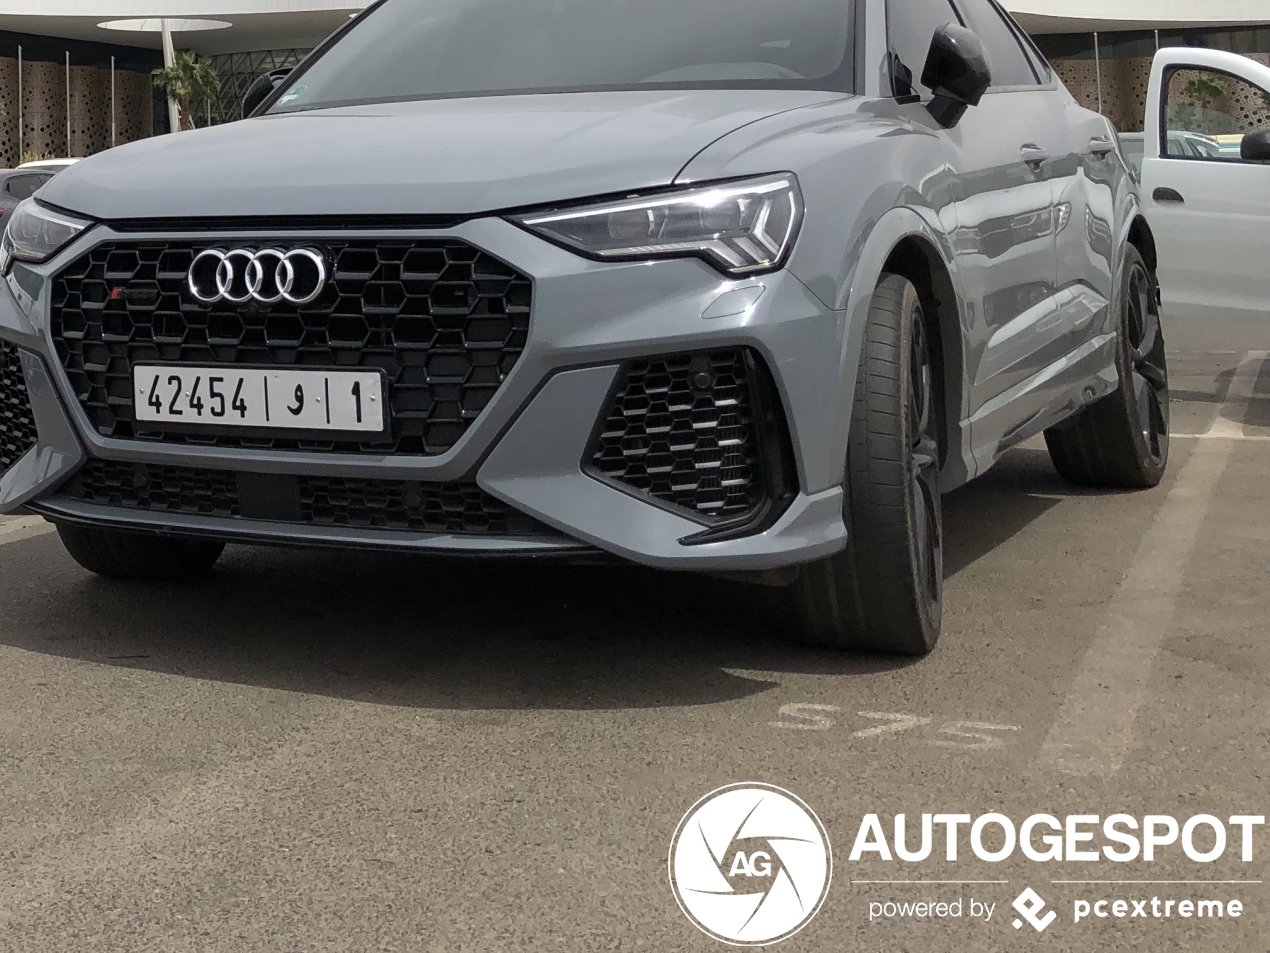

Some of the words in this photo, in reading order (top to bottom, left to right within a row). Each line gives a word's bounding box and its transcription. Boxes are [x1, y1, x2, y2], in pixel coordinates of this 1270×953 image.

[148, 374, 247, 418] 42454
[287, 383, 305, 416] و
[351, 381, 362, 423] 1
